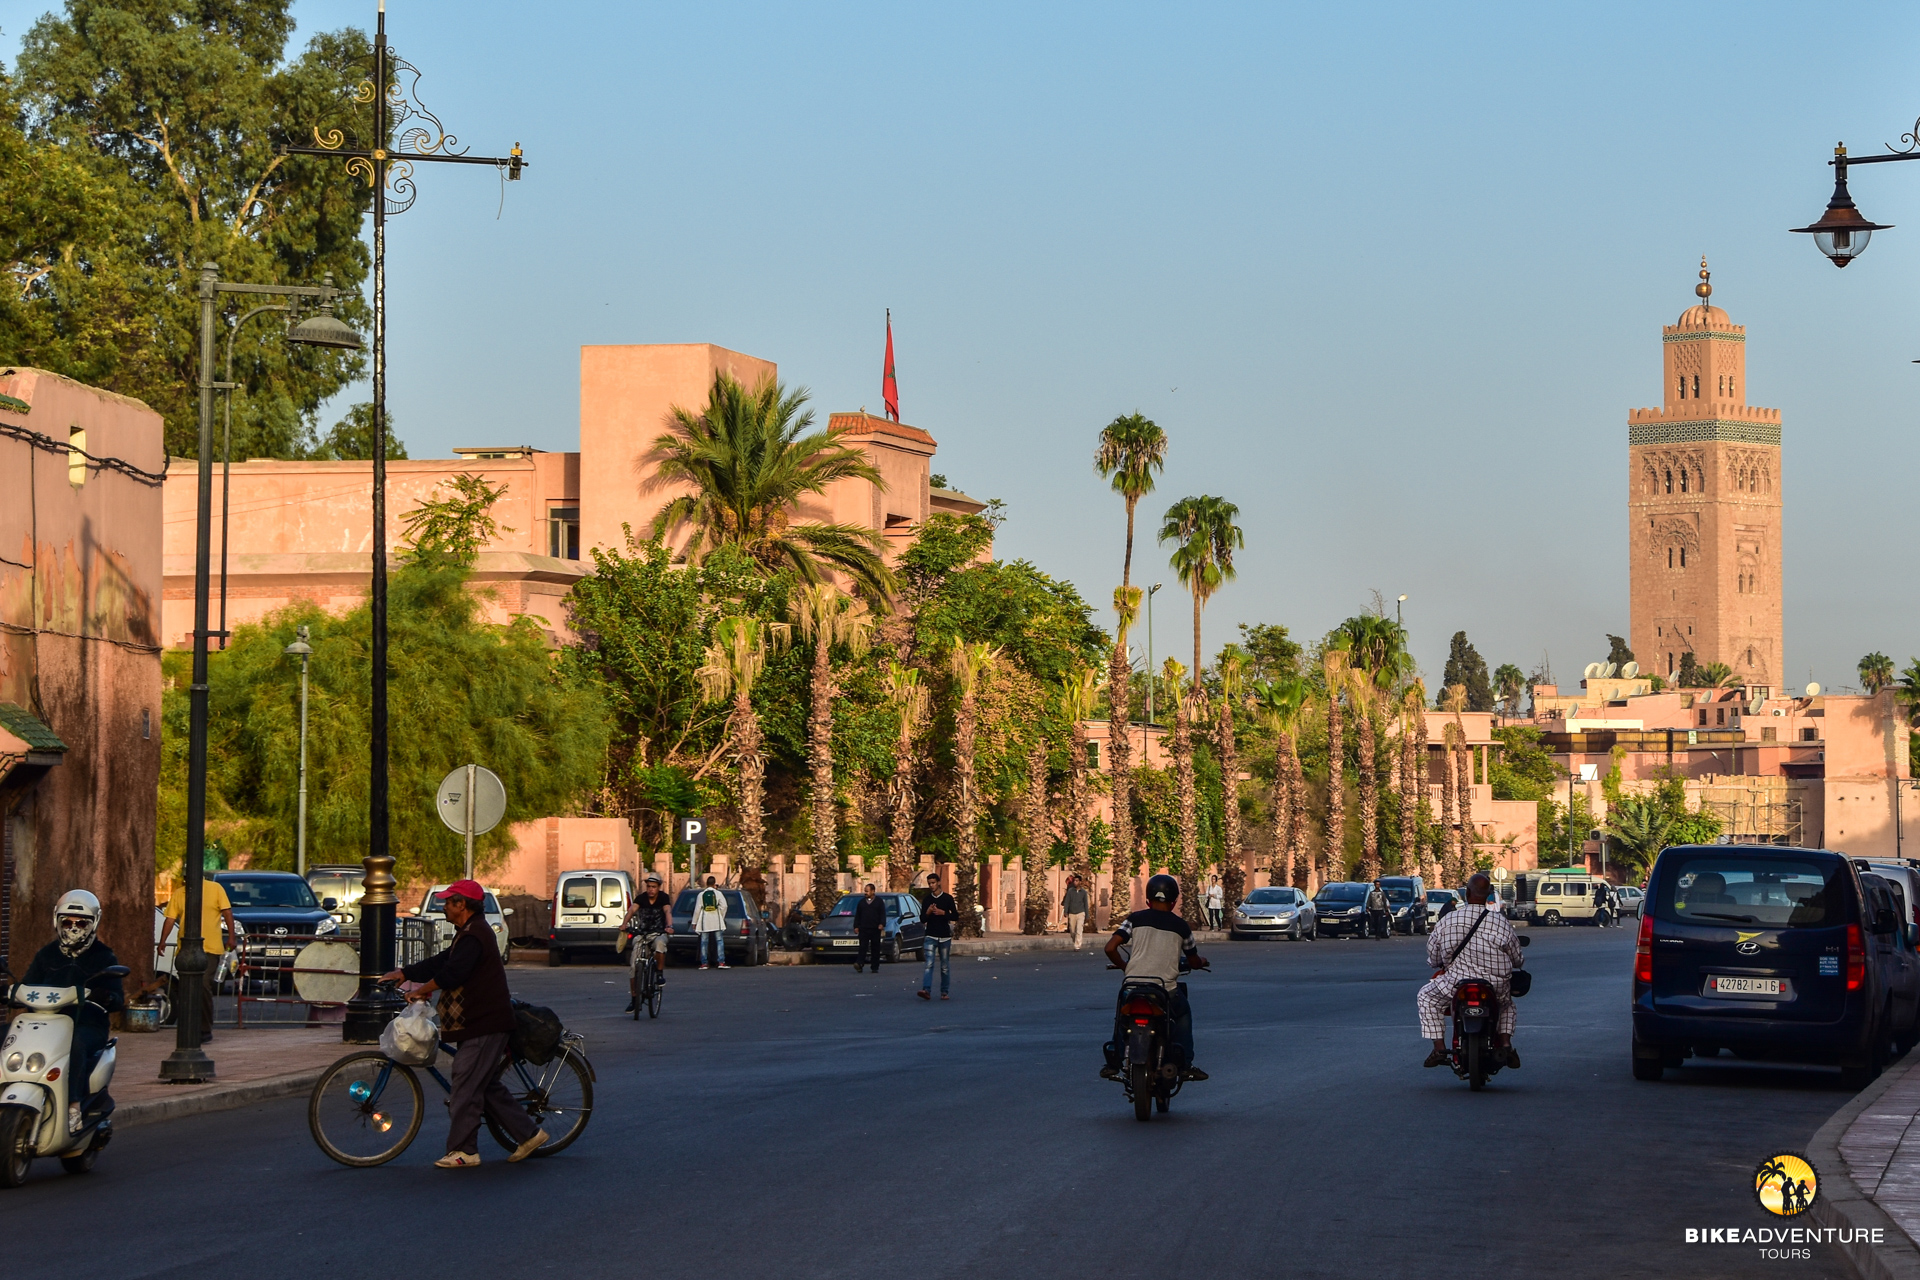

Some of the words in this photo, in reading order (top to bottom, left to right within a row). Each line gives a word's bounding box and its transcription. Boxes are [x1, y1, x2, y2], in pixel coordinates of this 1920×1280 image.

[686, 820, 701, 840] P
[1720, 978, 1748, 991] 42782
[1770, 980, 1776, 992] 6
